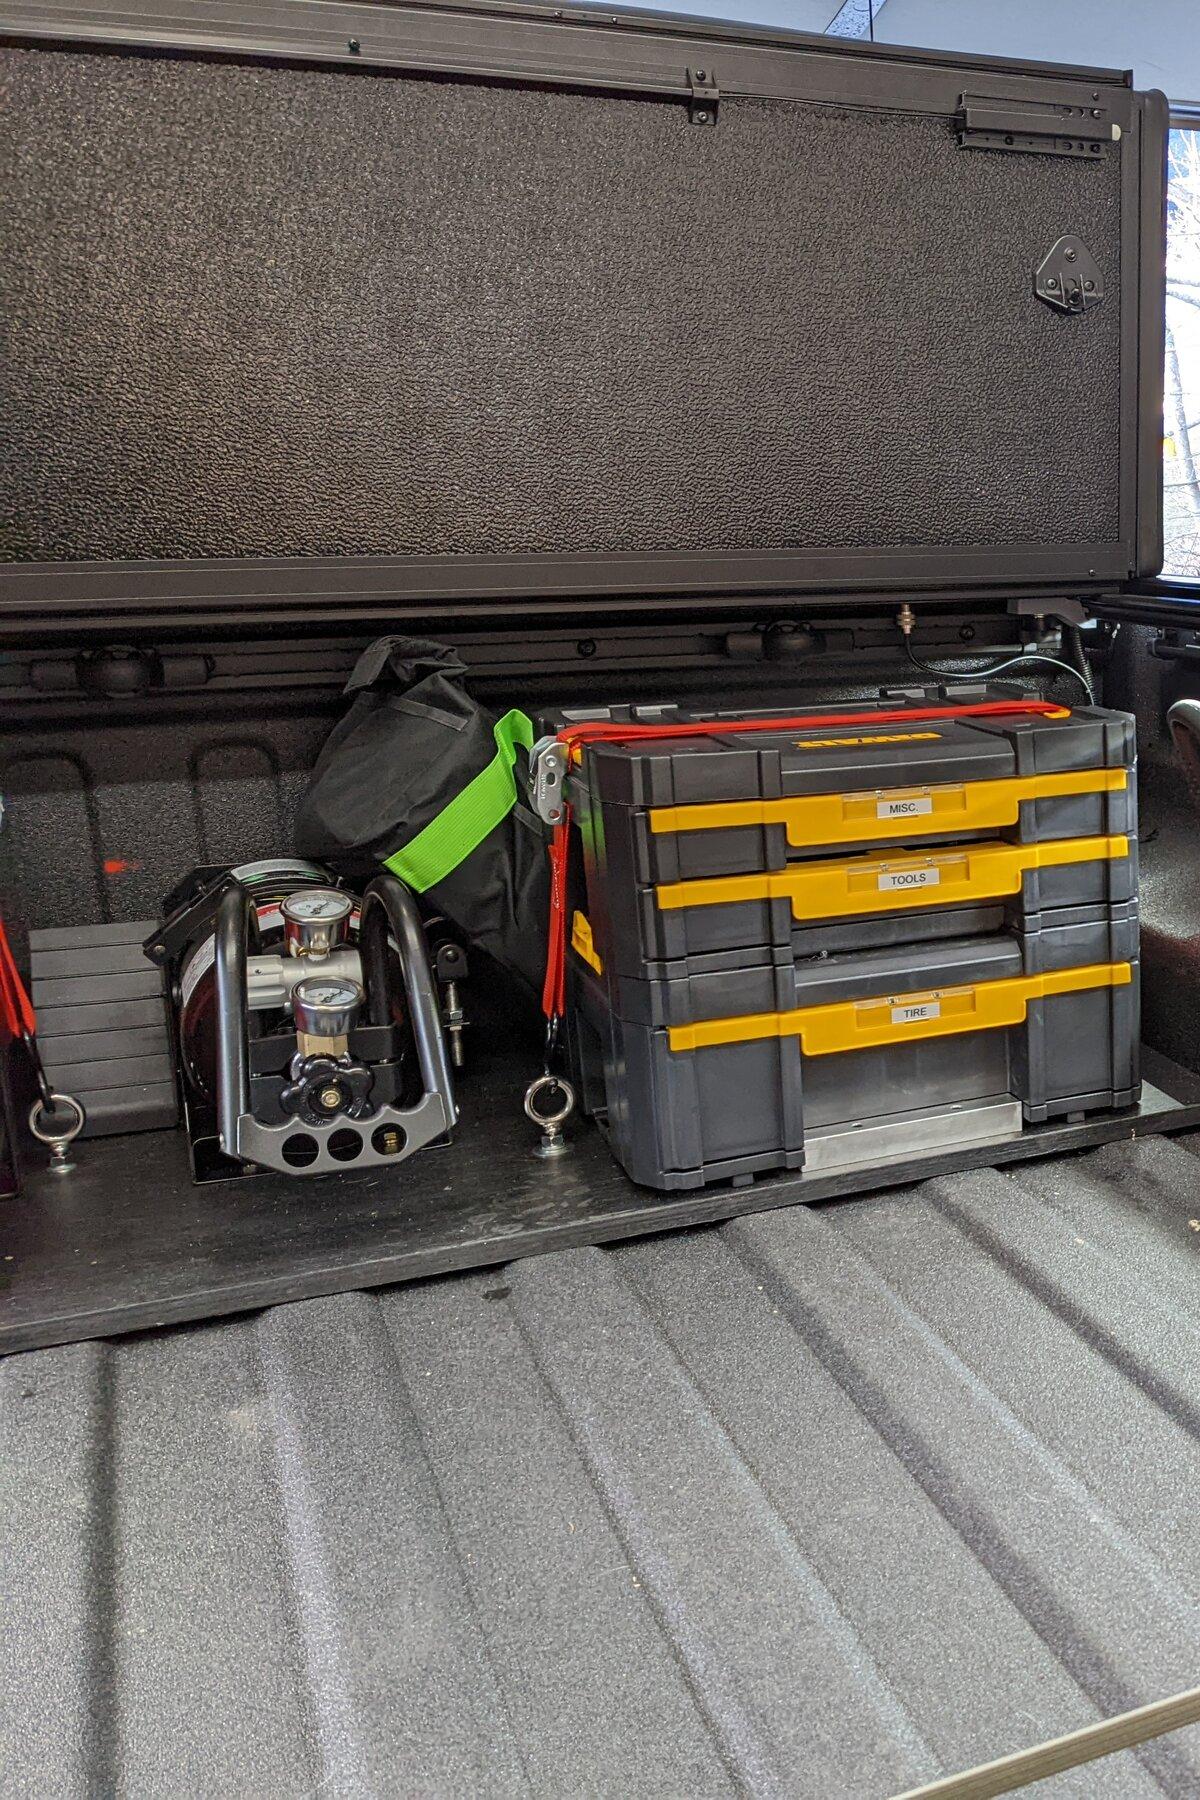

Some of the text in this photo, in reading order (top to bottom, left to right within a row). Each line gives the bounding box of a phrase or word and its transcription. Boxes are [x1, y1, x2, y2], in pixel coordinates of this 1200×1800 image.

[889, 803, 919, 814] MISC.
[890, 873, 927, 886] TOOLS
[904, 1007, 928, 1018] TIRE
